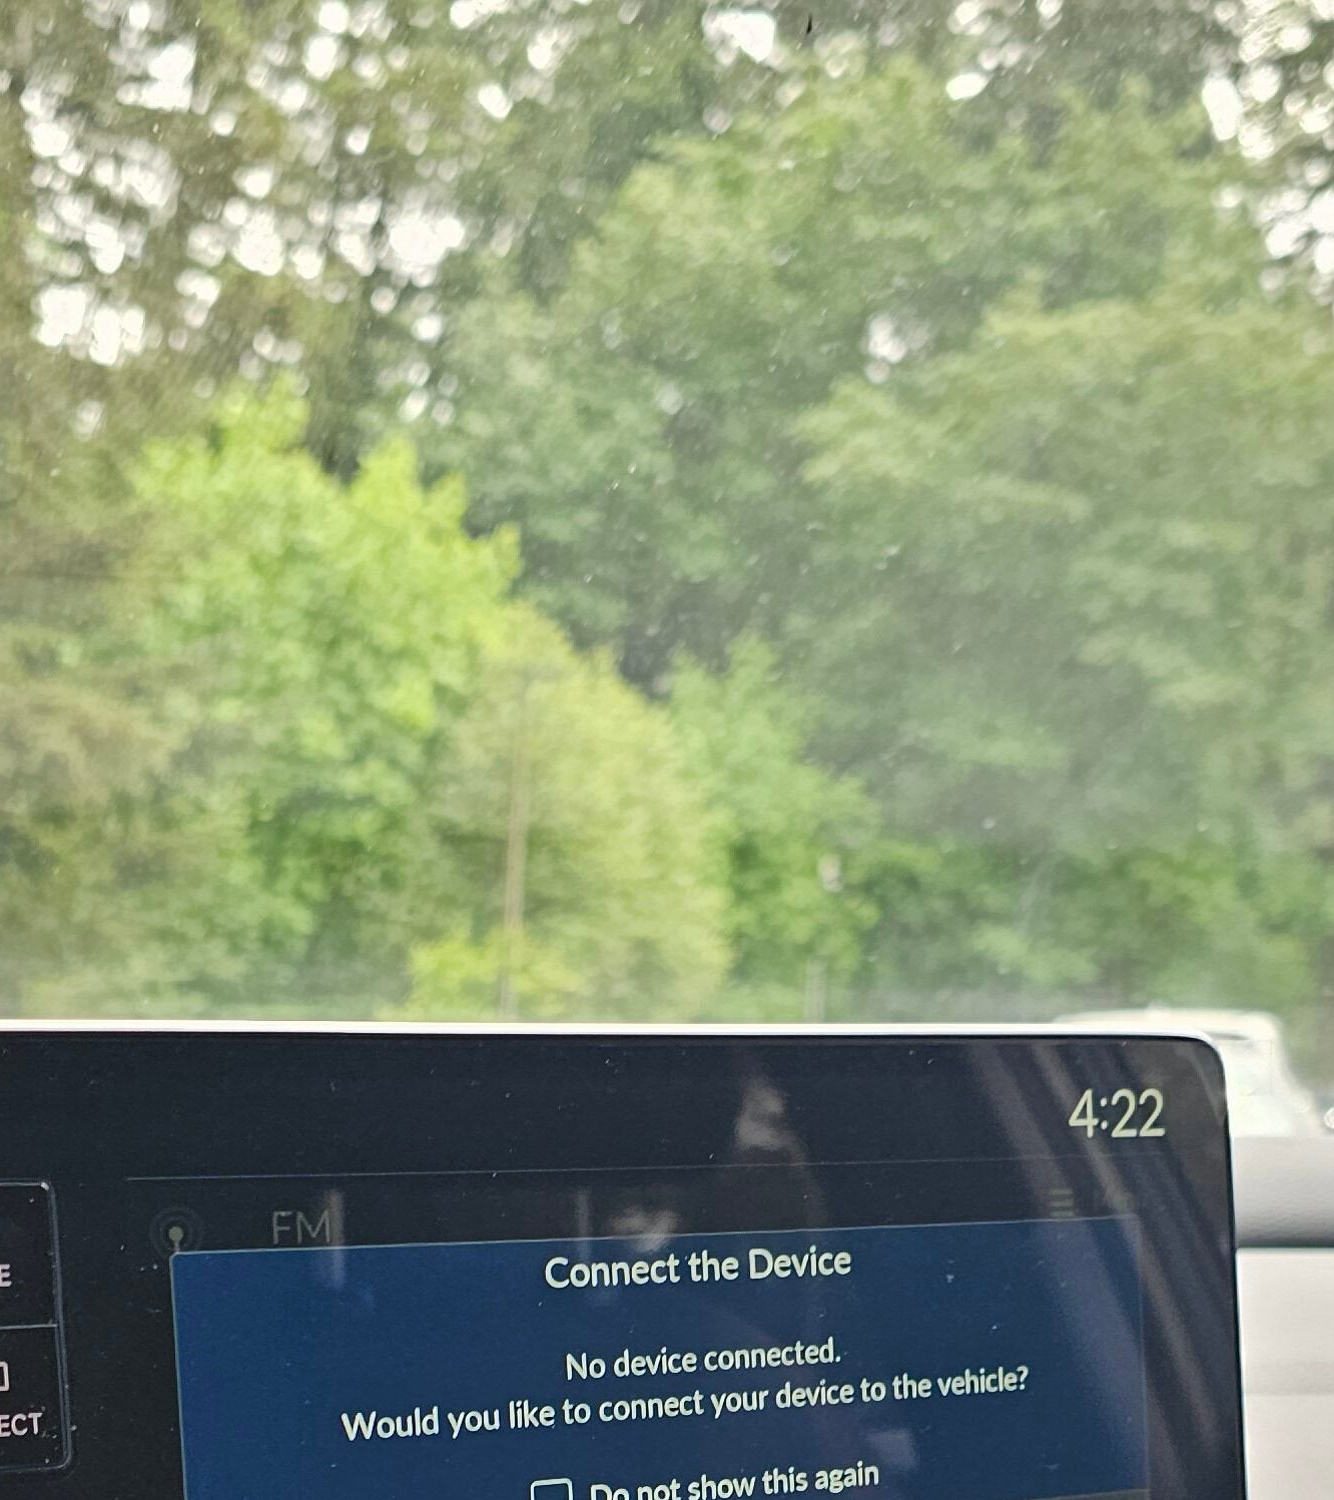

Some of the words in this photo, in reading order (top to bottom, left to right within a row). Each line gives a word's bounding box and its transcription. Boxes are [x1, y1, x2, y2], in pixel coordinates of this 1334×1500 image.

[1068, 1088, 1165, 1138] 4:22
[272, 1208, 331, 1244] FM
[545, 1253, 679, 1289] Connect
[688, 1250, 739, 1282] the
[749, 1245, 852, 1280] Device
[566, 1353, 605, 1381] No
[614, 1346, 697, 1378] device
[703, 1336, 841, 1371] connected.
[341, 1405, 439, 1441] Would
[447, 1409, 500, 1439] you
[508, 1400, 555, 1429] like
[562, 1399, 591, 1425] to
[599, 1390, 704, 1422] connect
[711, 1389, 769, 1419] your
[776, 1378, 855, 1409] device
[860, 1377, 886, 1403] to
[892, 1372, 932, 1400] the
[937, 1365, 1029, 1396] vehicle?
[761, 1466, 808, 1495] this
[814, 1460, 880, 1494] again
